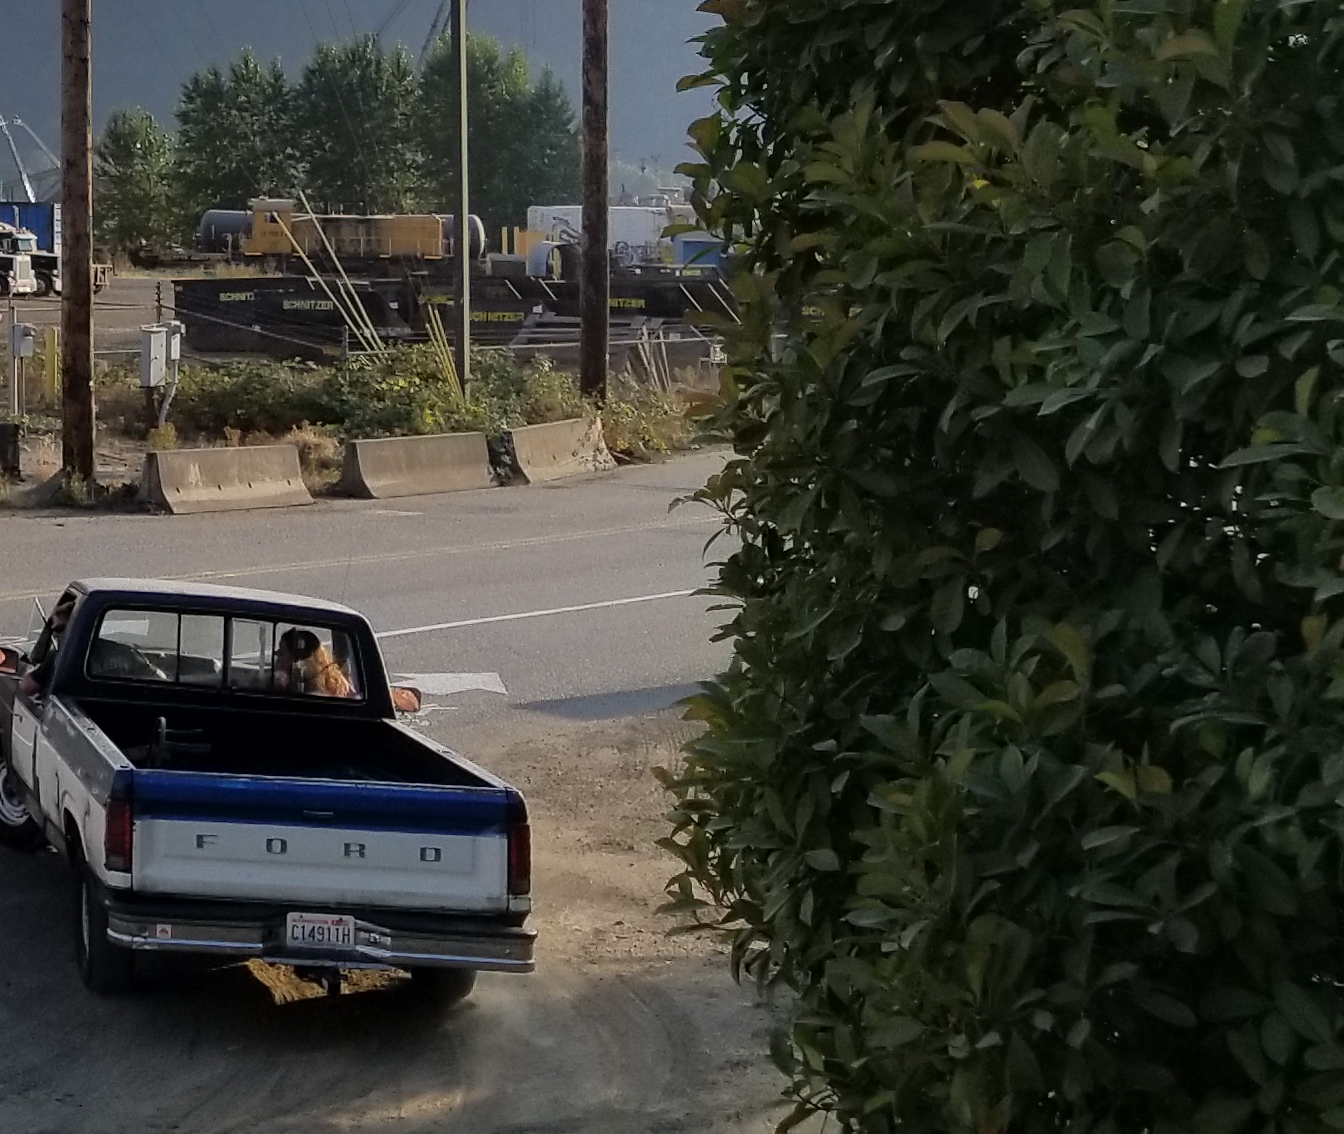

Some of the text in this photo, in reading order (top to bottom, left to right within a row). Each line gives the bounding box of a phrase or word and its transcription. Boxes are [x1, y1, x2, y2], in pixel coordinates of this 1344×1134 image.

[283, 300, 334, 310] SCHNITZER
[195, 834, 442, 862] FORD
[292, 925, 351, 944] C14911H
